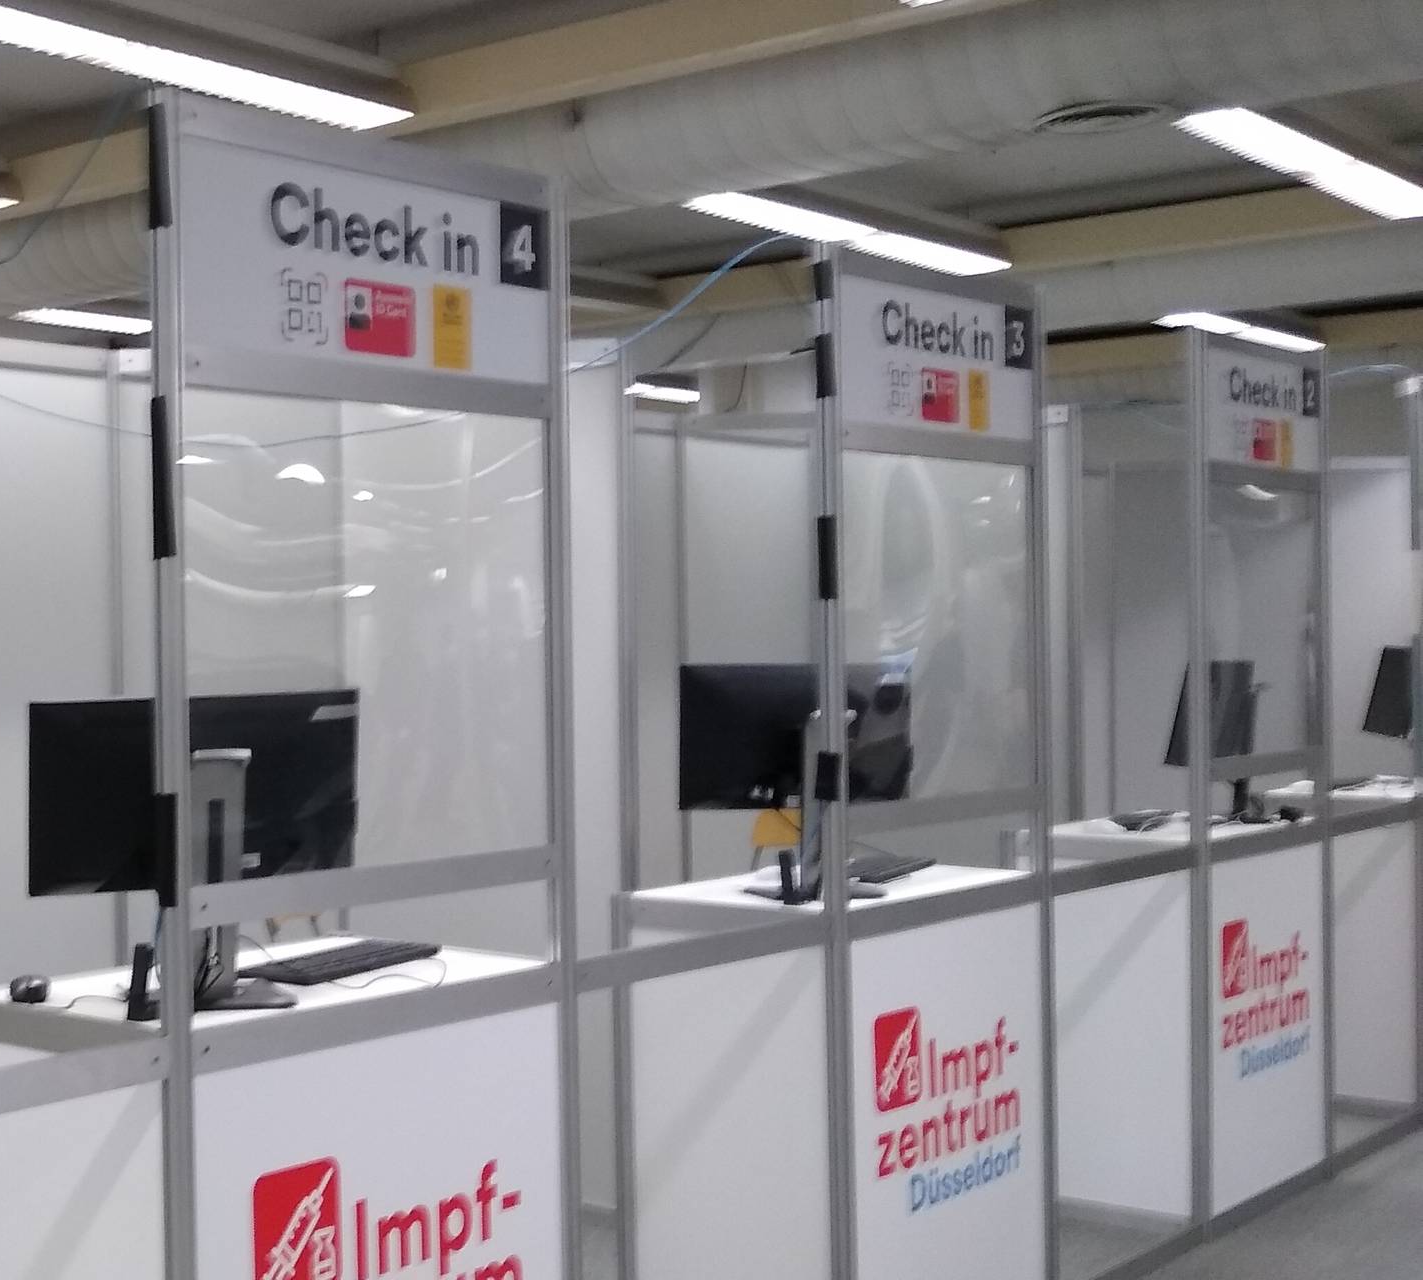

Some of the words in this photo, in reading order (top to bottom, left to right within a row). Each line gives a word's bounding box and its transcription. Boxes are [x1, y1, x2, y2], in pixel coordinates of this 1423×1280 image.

[270, 182, 428, 268] Check
[441, 211, 481, 277] in
[511, 224, 537, 272] 4
[882, 299, 966, 358] Check
[973, 315, 994, 361] in
[1011, 320, 1025, 358] 3
[1229, 365, 1279, 408] Check
[1283, 375, 1297, 412] in
[929, 1015, 1020, 1099] Impf-
[1223, 987, 1311, 1049] zentrum
[878, 1087, 1021, 1177] zentrum
[909, 1134, 1021, 1213] Düsseldorf
[354, 1158, 522, 1280] Impf-
